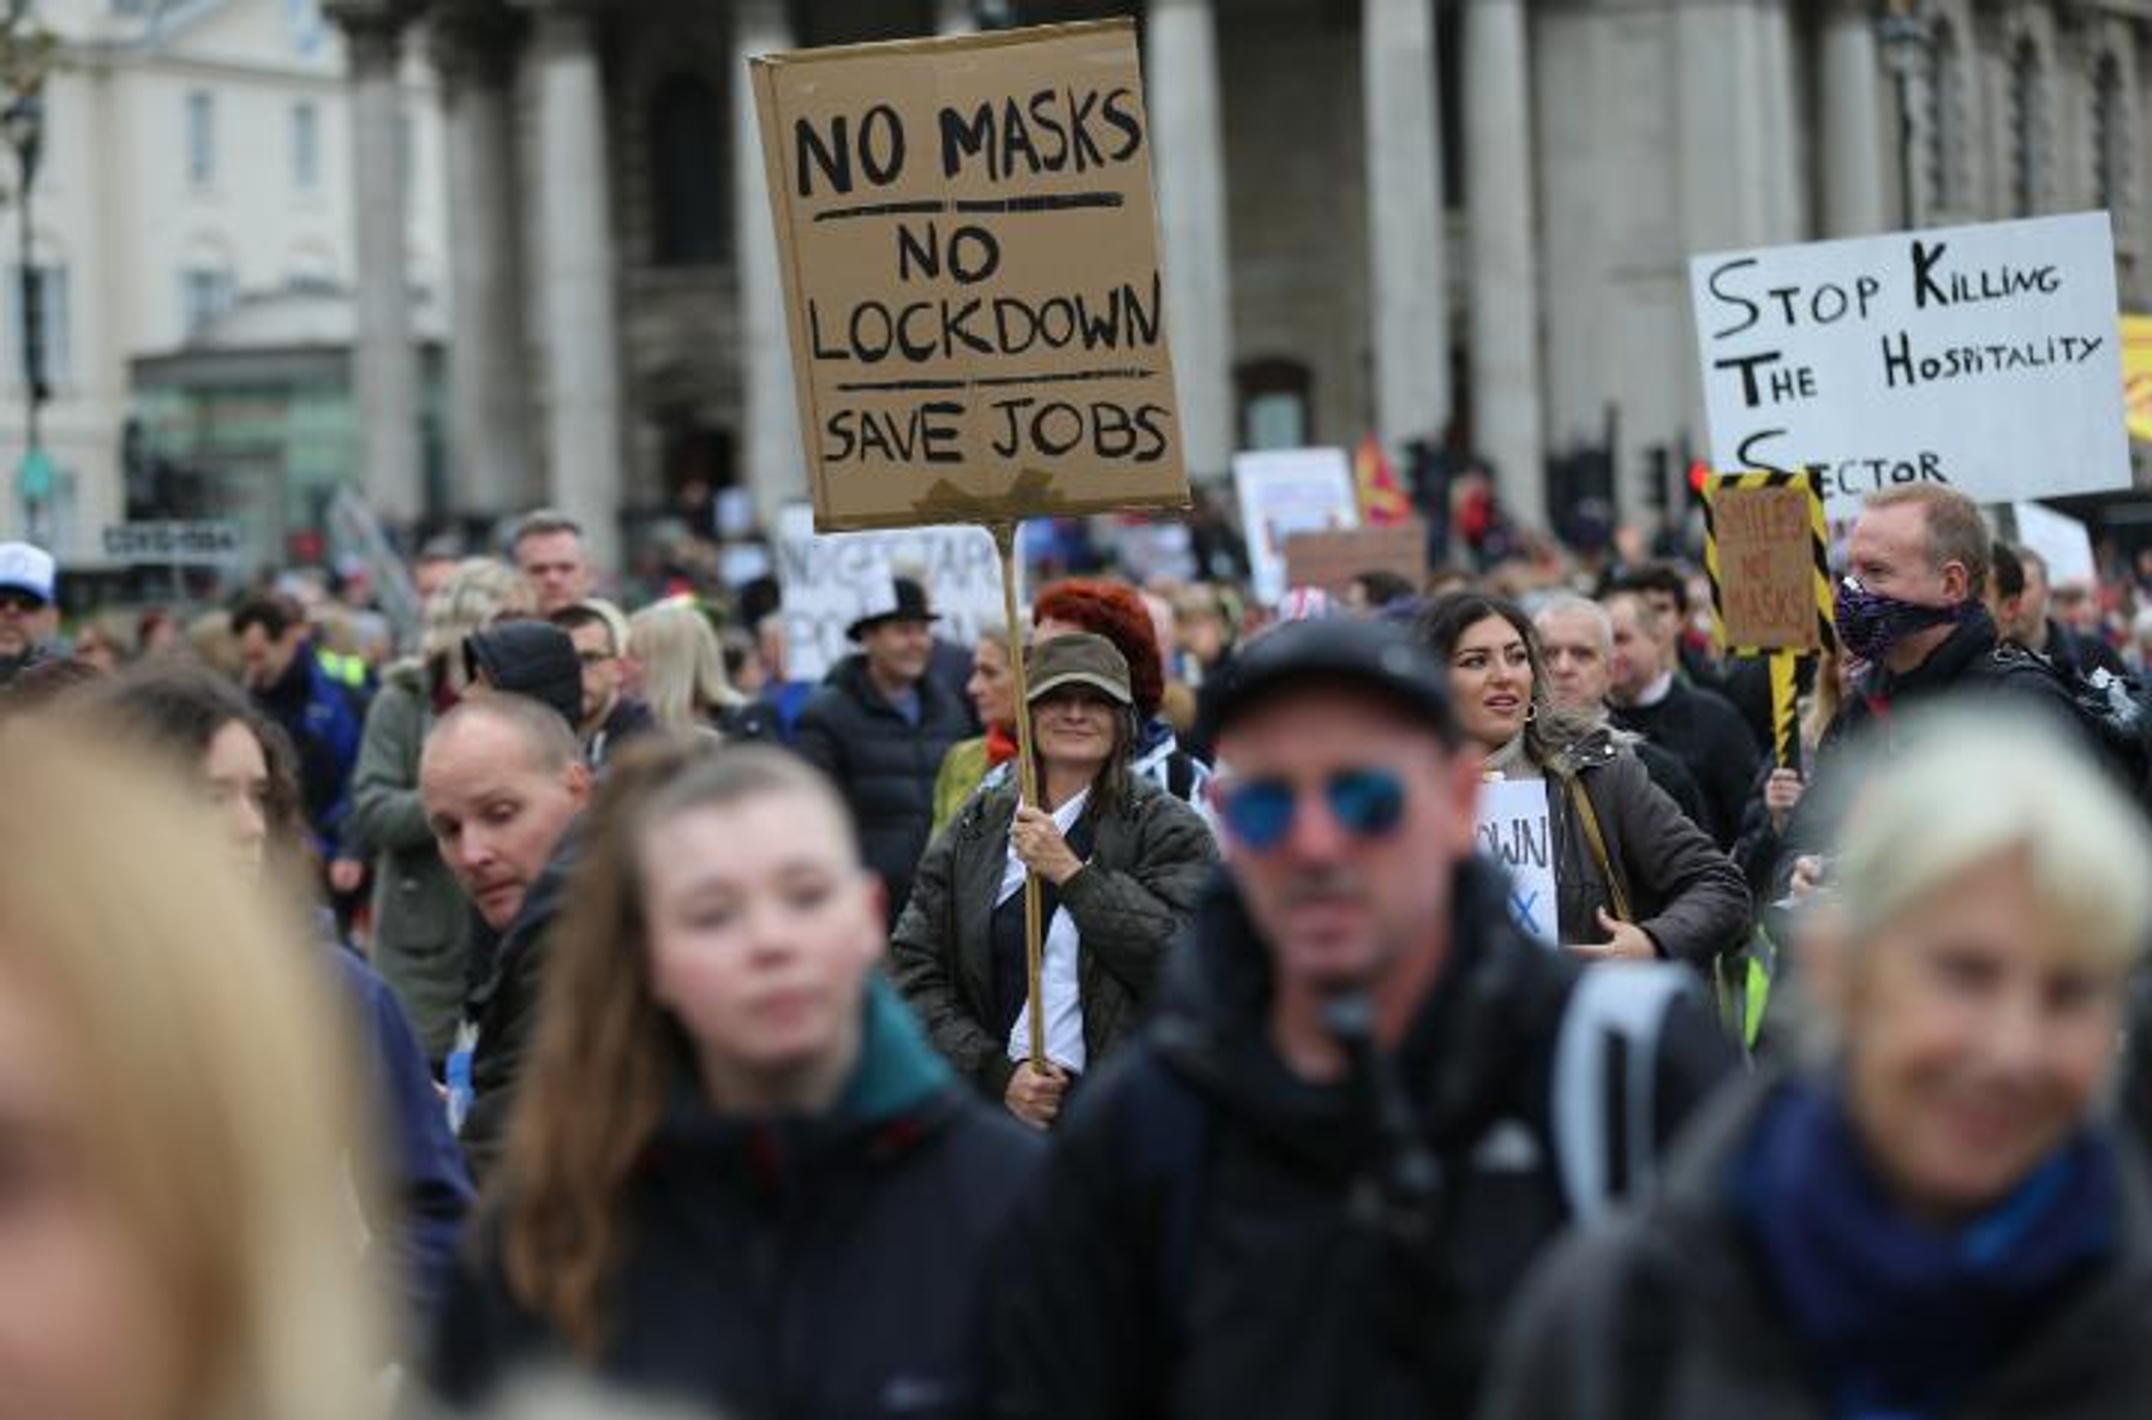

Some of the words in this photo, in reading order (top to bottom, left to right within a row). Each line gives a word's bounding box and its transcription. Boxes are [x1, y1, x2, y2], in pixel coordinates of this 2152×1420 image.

[796, 105, 905, 197] NO
[939, 84, 1141, 181] MASKS
[897, 221, 998, 284] NO
[809, 270, 1162, 363] LOCKDOWN
[824, 403, 964, 462] SAVE
[992, 398, 1169, 462] JOBS
